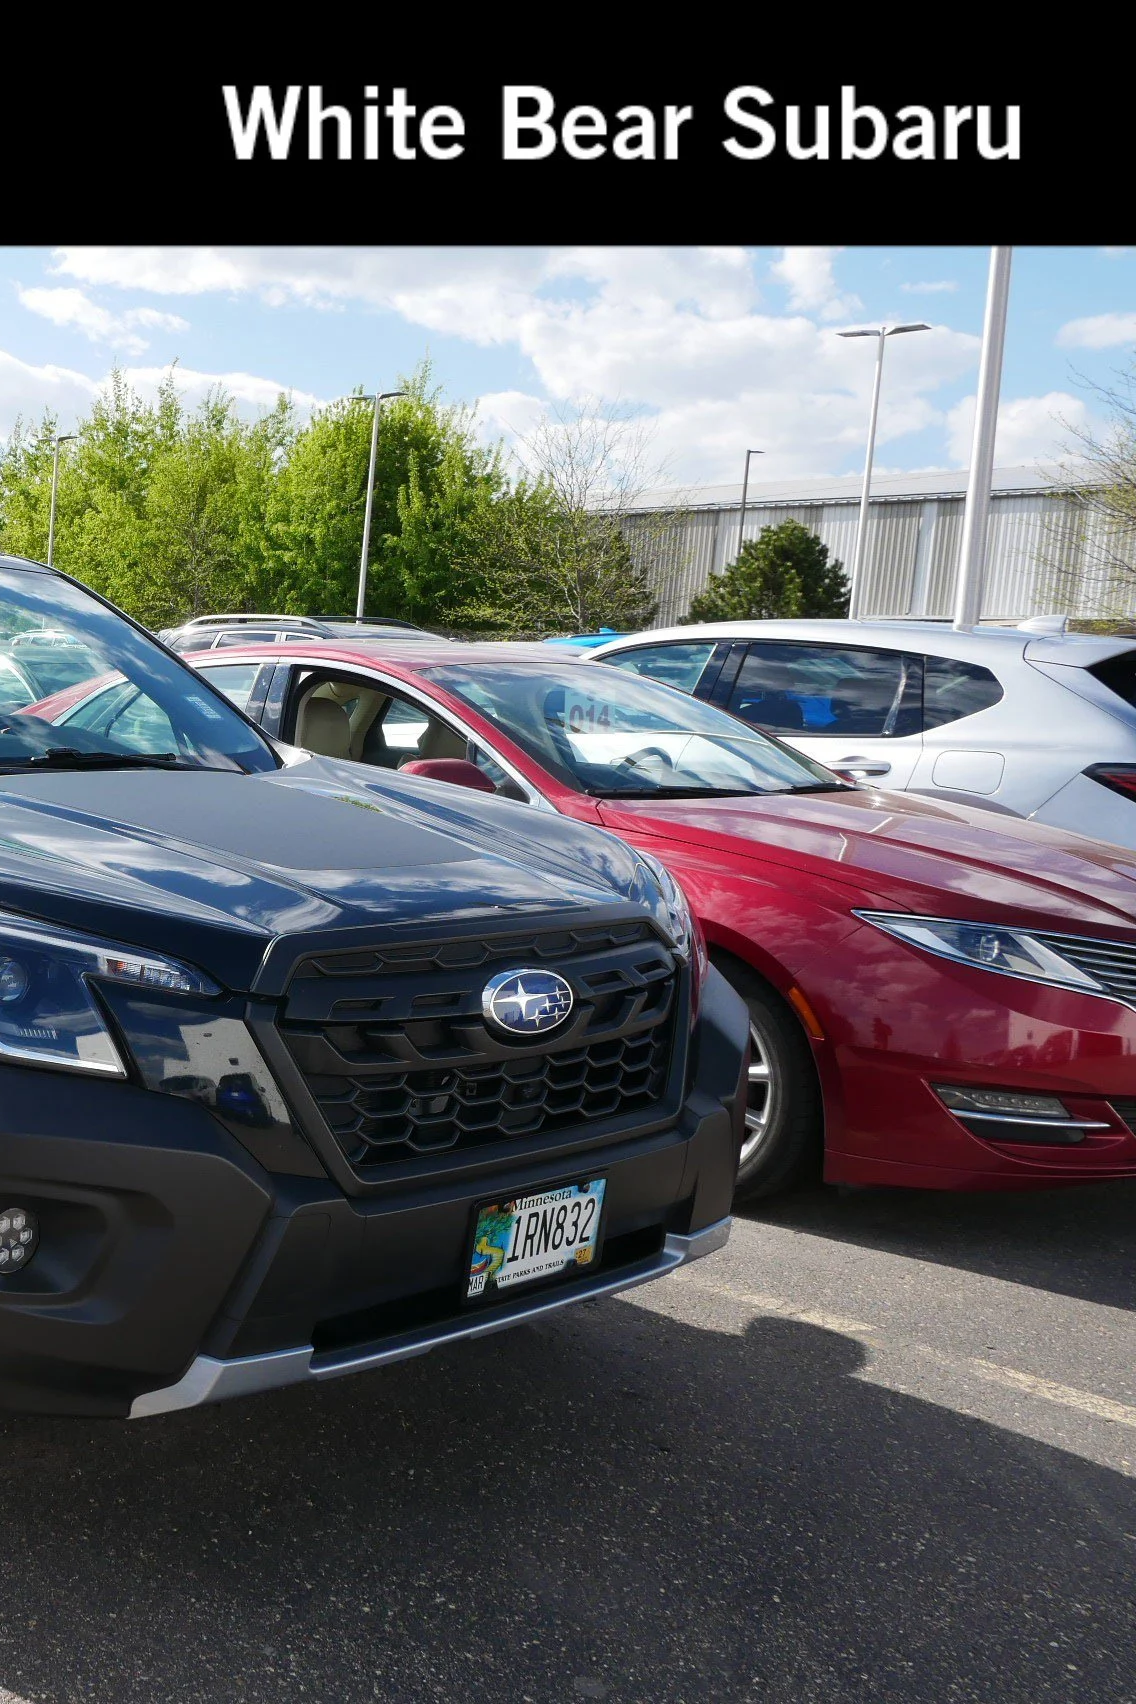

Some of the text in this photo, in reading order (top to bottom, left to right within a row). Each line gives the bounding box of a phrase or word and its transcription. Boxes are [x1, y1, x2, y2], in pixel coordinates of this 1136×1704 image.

[569, 704, 611, 733] 014
[512, 1189, 572, 1213] Minnesota
[507, 1198, 596, 1264] 1RN832
[512, 1268, 531, 1280] PARKS
[531, 1265, 544, 1274] AND
[545, 1259, 565, 1270] TRAILS
